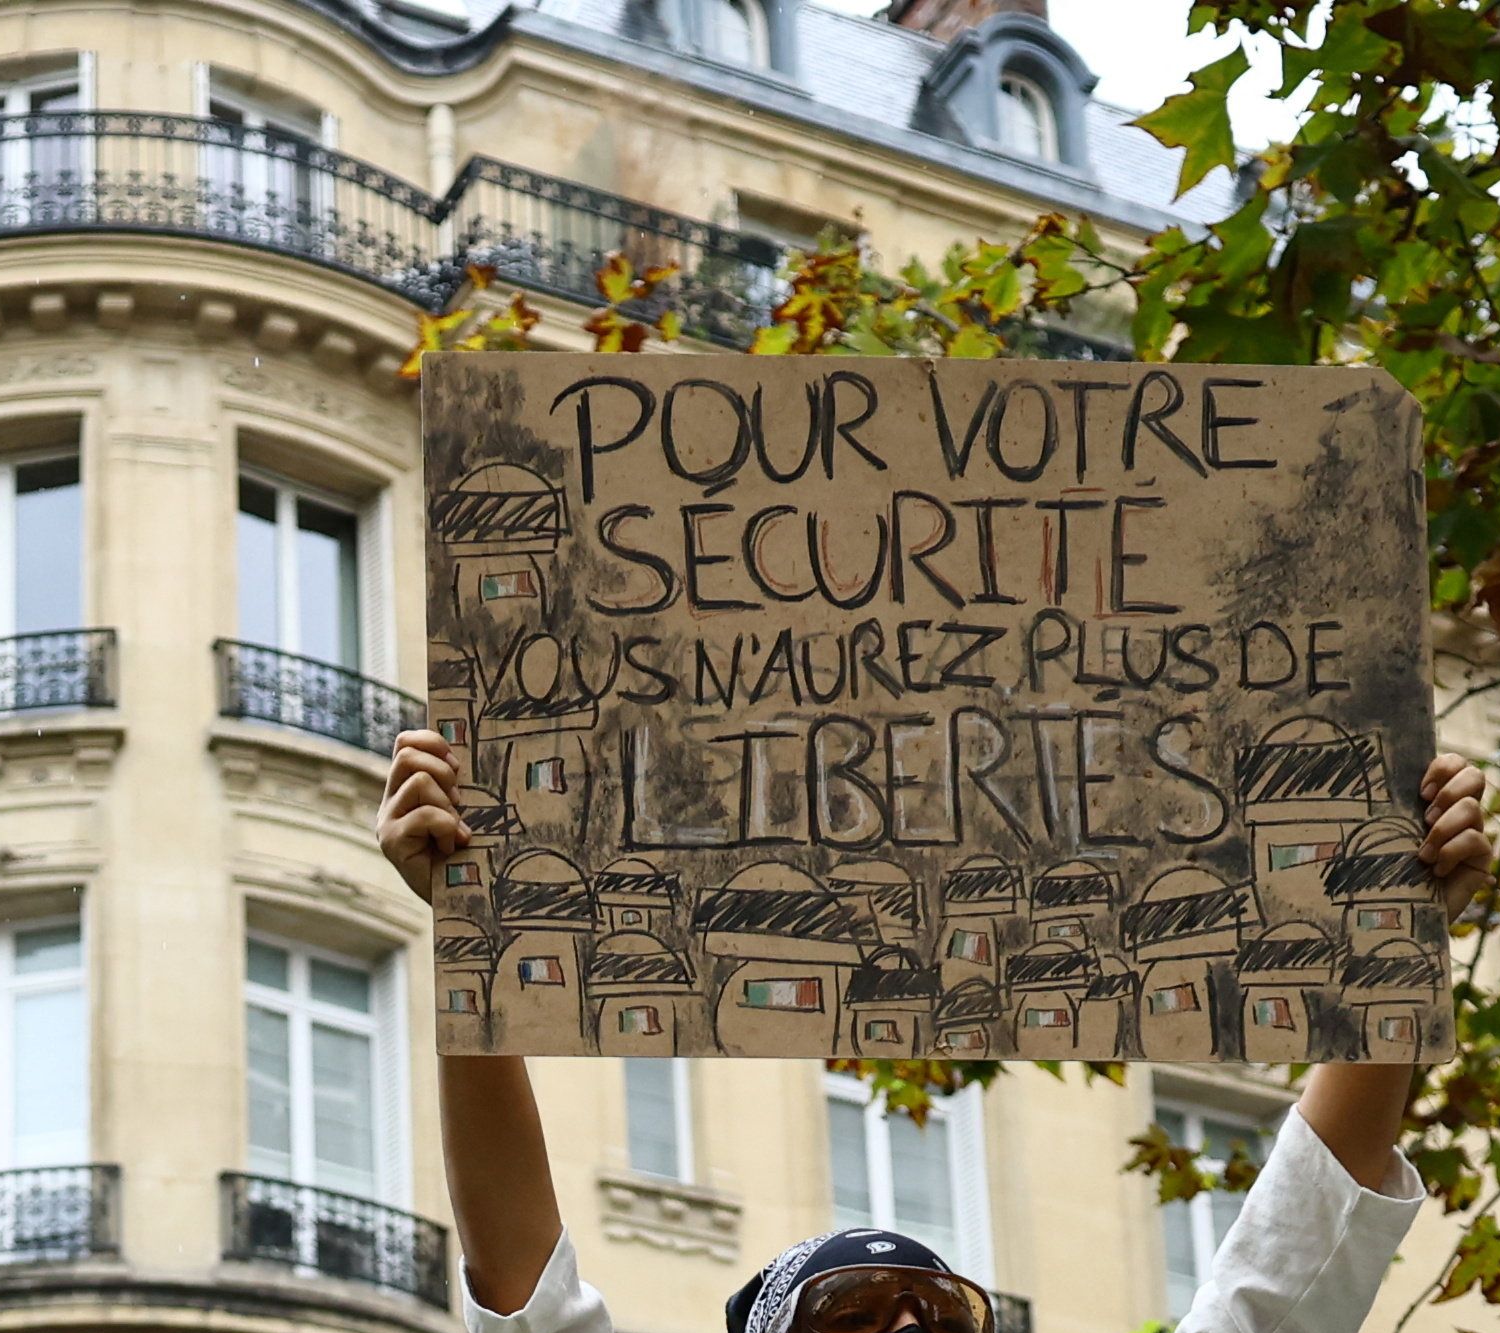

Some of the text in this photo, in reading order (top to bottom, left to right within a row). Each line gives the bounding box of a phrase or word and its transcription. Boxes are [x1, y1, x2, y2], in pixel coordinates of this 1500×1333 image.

[549, 370, 1278, 504] POUR VOTRE
[587, 477, 1186, 616] SÉCURITÉ
[474, 608, 1351, 709] VOUS N'AUREZ PLUS DE
